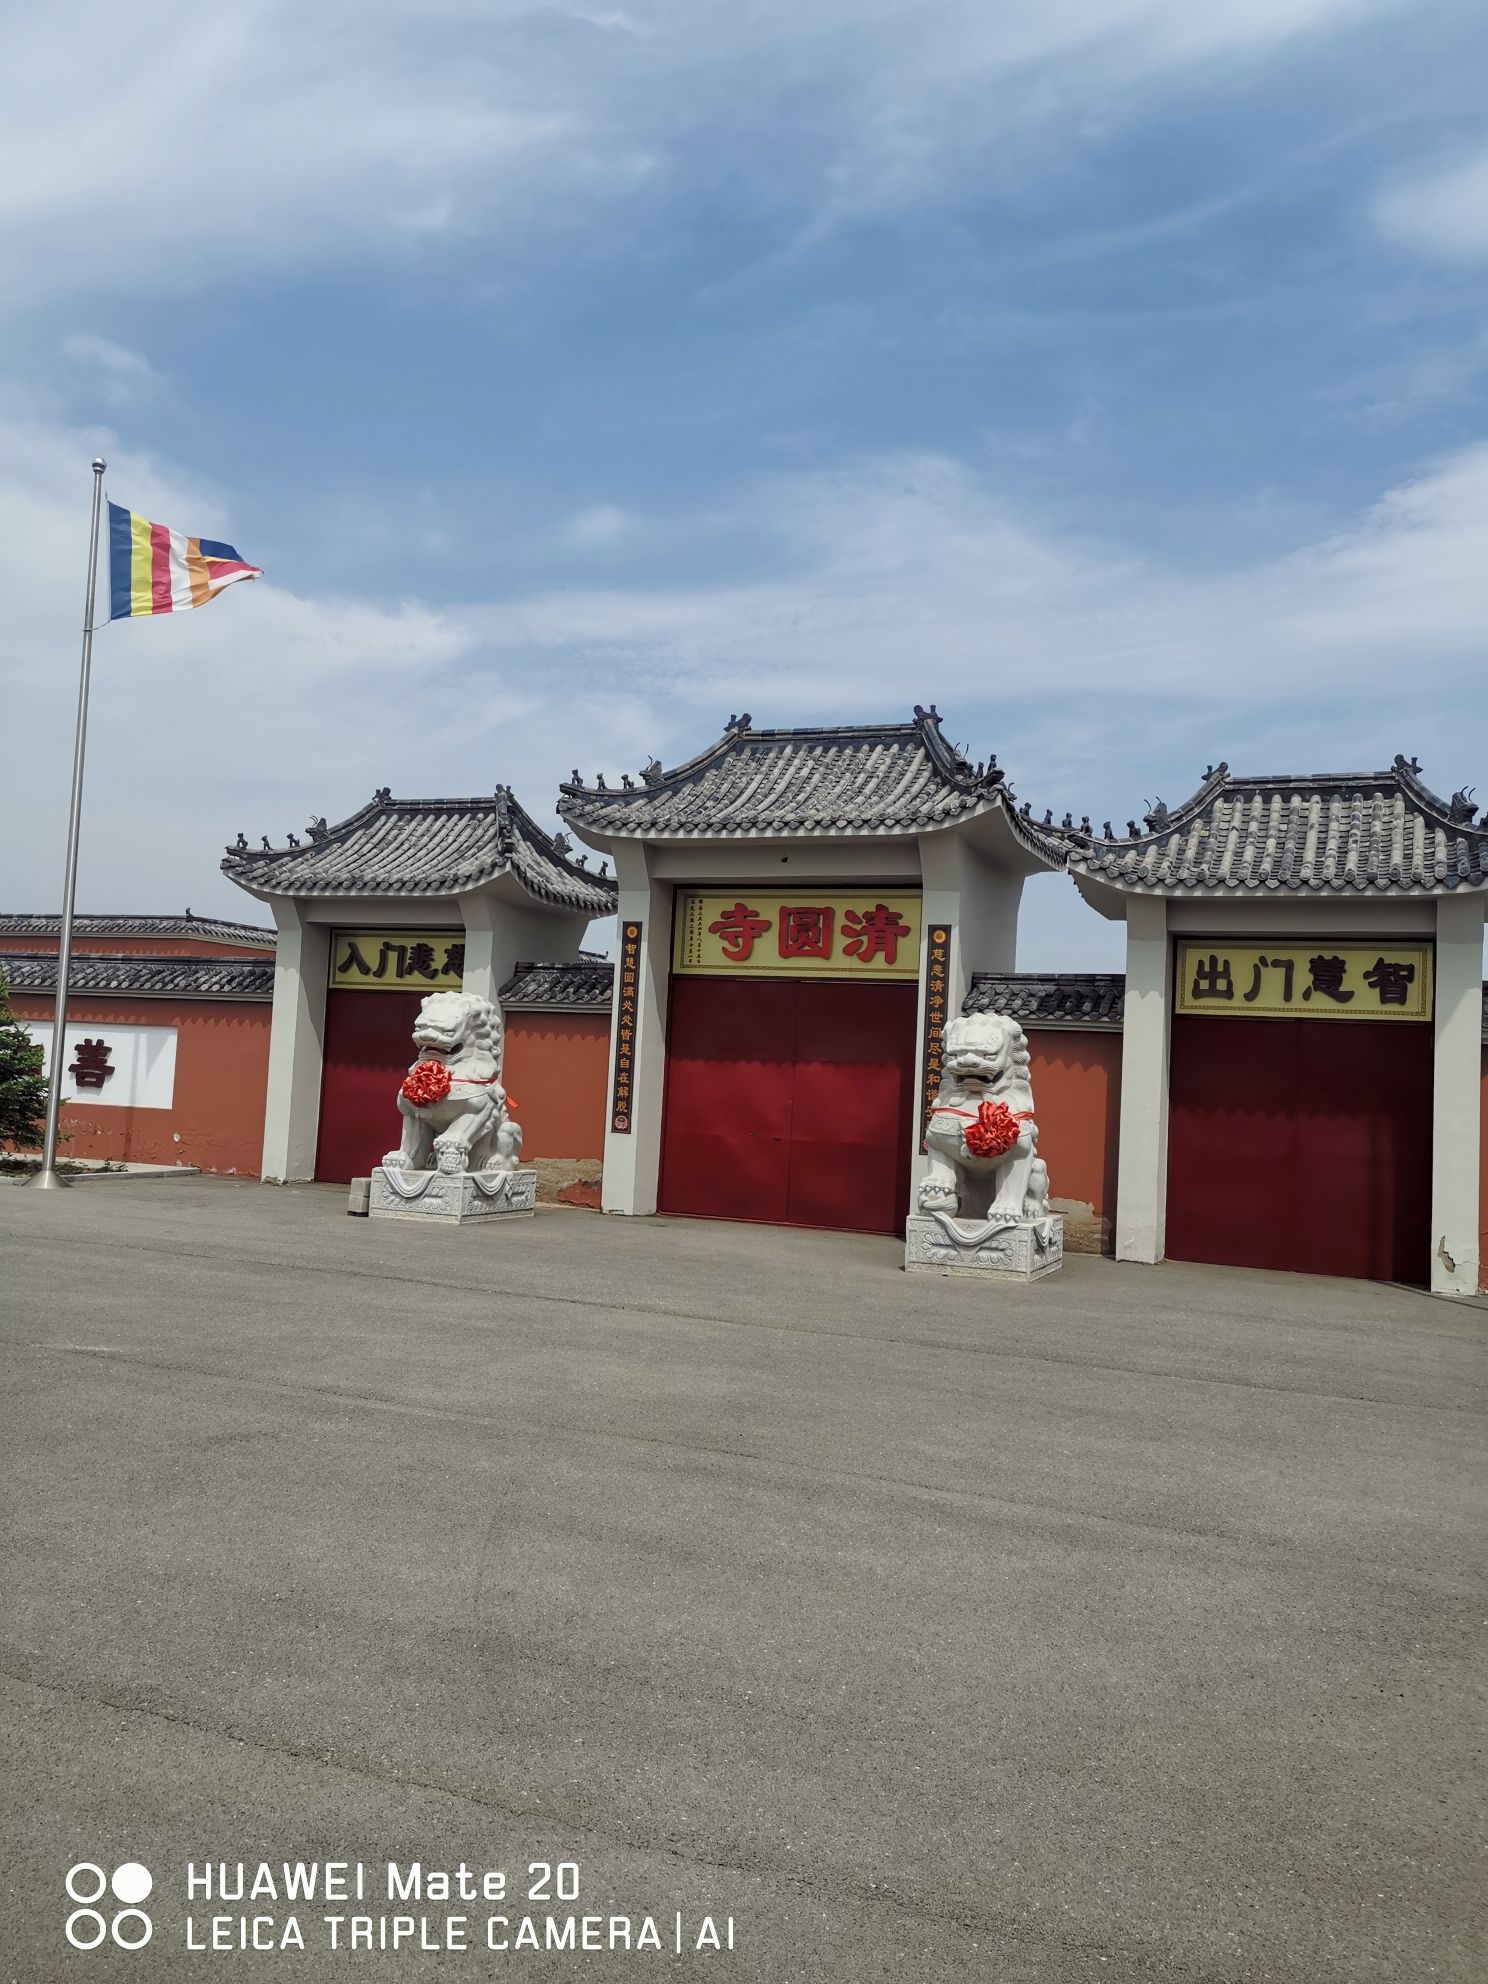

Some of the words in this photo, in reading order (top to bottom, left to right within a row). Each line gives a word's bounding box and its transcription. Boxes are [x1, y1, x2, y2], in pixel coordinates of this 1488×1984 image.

[708, 902, 911, 965] 清圆寺
[1191, 954, 1415, 1006] 智慧门出
[68, 1038, 116, 1088] 善
